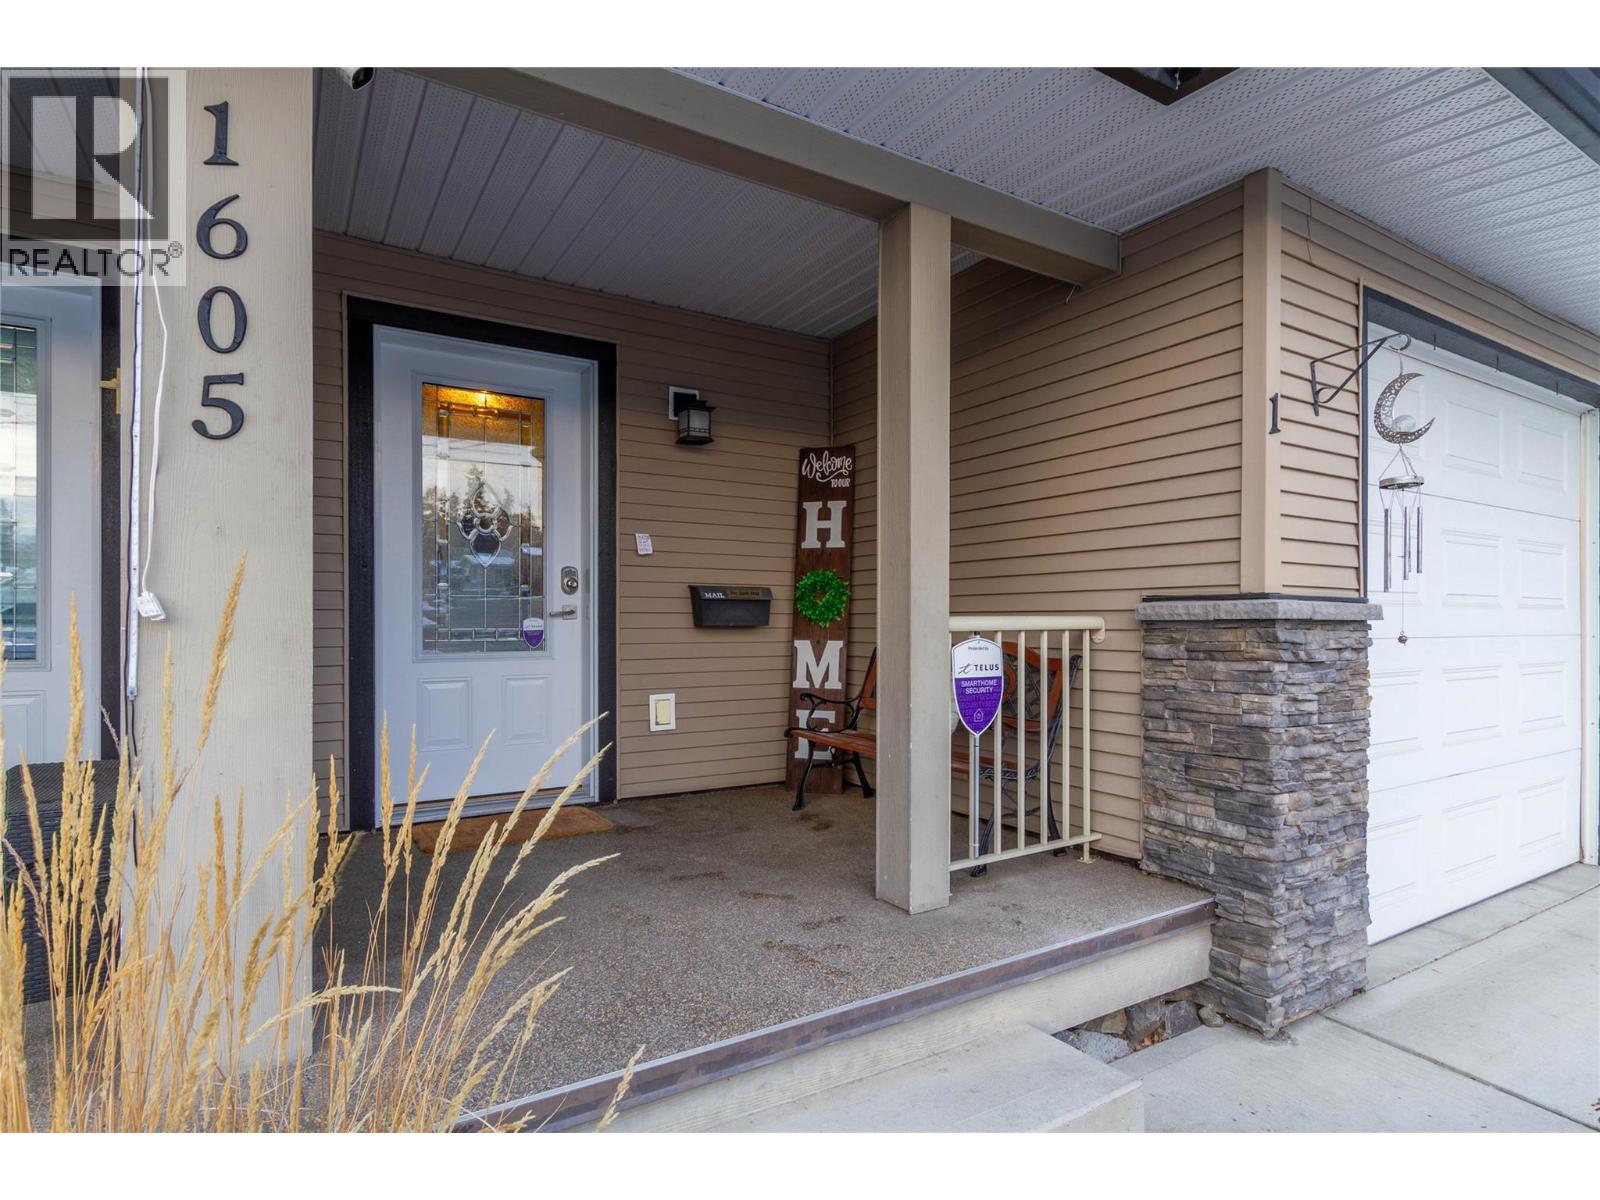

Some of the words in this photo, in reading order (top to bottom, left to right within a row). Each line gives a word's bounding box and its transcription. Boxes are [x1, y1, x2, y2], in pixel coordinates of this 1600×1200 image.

[191, 100, 249, 440] 1605
[1269, 392, 1281, 435] 1
[801, 450, 853, 479] Welcome
